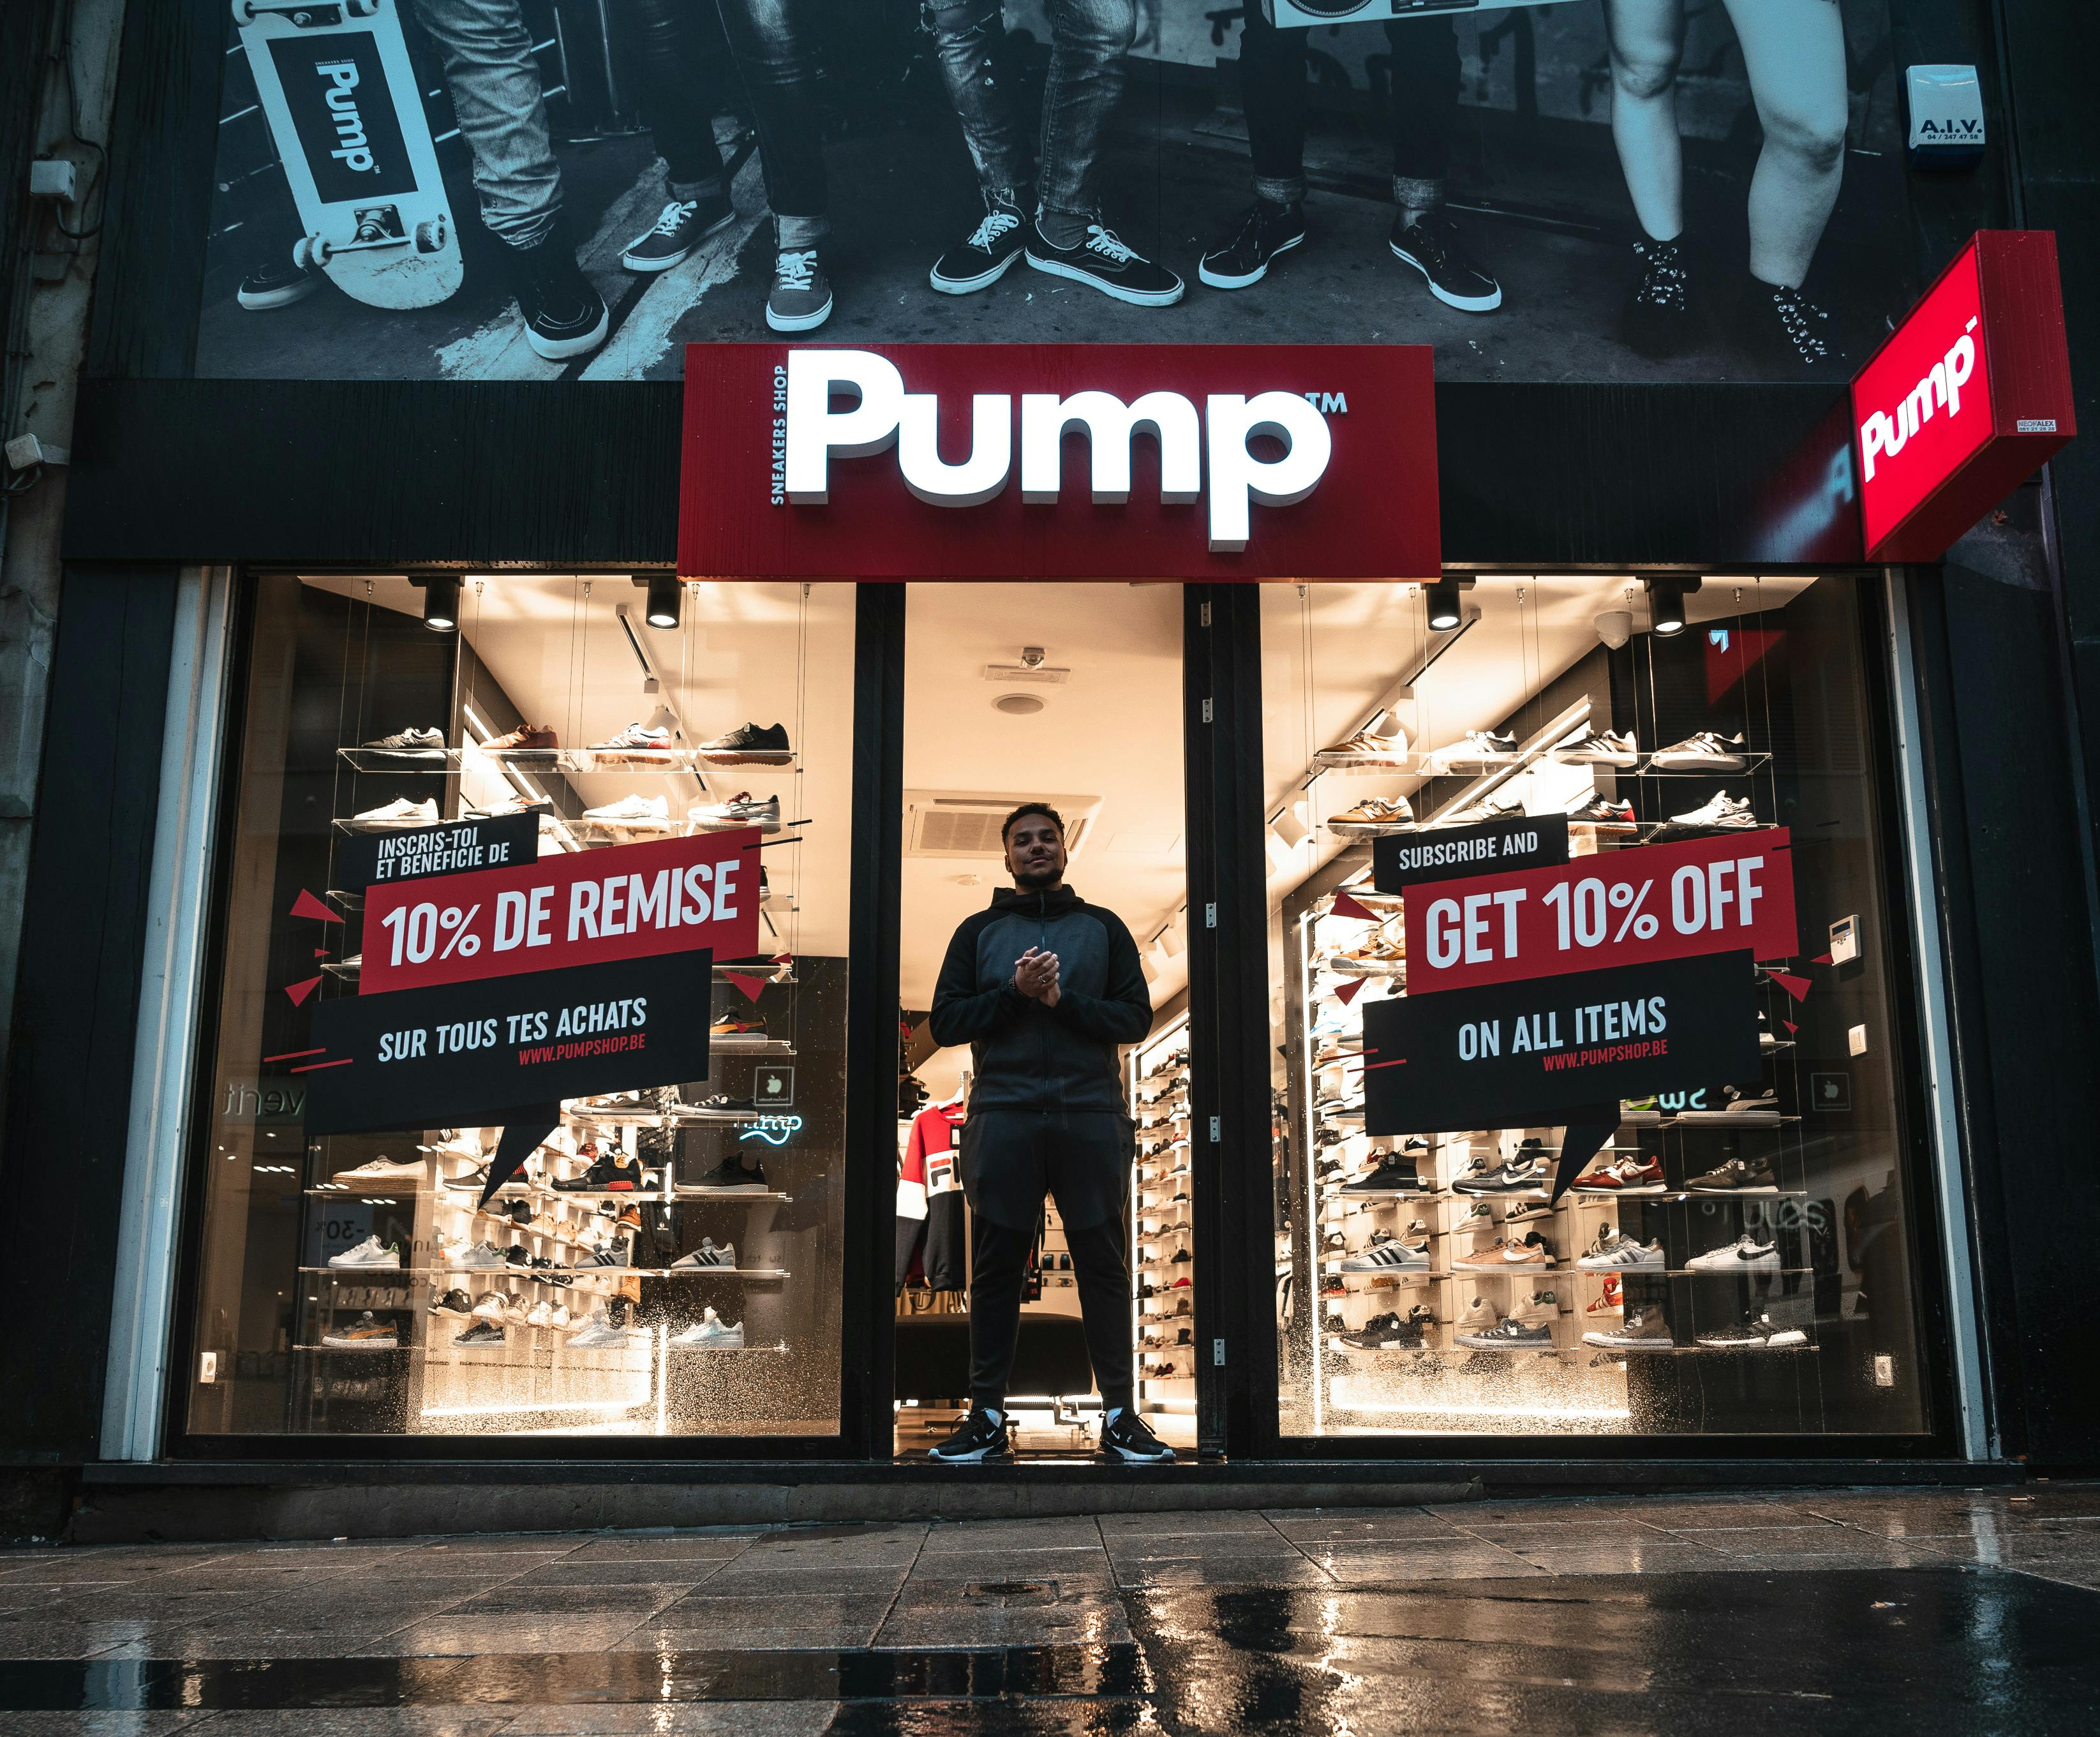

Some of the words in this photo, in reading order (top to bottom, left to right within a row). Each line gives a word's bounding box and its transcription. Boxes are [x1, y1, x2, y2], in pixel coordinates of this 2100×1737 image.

[316, 63, 374, 172] Pump
[1920, 119, 1983, 133] A.I.V.
[773, 365, 787, 411] SHOP
[1305, 392, 1348, 414] TM
[1861, 334, 1975, 483] Pump
[771, 419, 786, 505] SNEAKERS
[786, 349, 1332, 546] Pump
[376, 858, 396, 879] ET
[400, 846, 484, 876] BENEFICIE
[489, 842, 510, 863] DE
[378, 827, 478, 858] INSCRIS-TOI
[1399, 837, 1497, 870] SUBSCRIBE
[1502, 832, 1538, 856] AND
[381, 902, 481, 967] 10%
[493, 885, 555, 952] DE
[567, 859, 740, 942] REMISE
[1426, 888, 1527, 969] GET
[1542, 877, 1658, 951] 10%
[1671, 855, 1764, 935] OFF
[378, 1029, 427, 1062] SUR
[436, 1018, 498, 1054] TOUS
[507, 1011, 549, 1044] TES
[555, 997, 647, 1038] ACHATS
[519, 1033, 646, 1065] WWW.PUMPSHOP.BE
[1459, 1020, 1500, 1061] ON
[1512, 1011, 1563, 1054] ALL
[1575, 996, 1666, 1043] ITEMS
[1543, 1039, 1668, 1071] WWW.PUMPSHOP.BE
